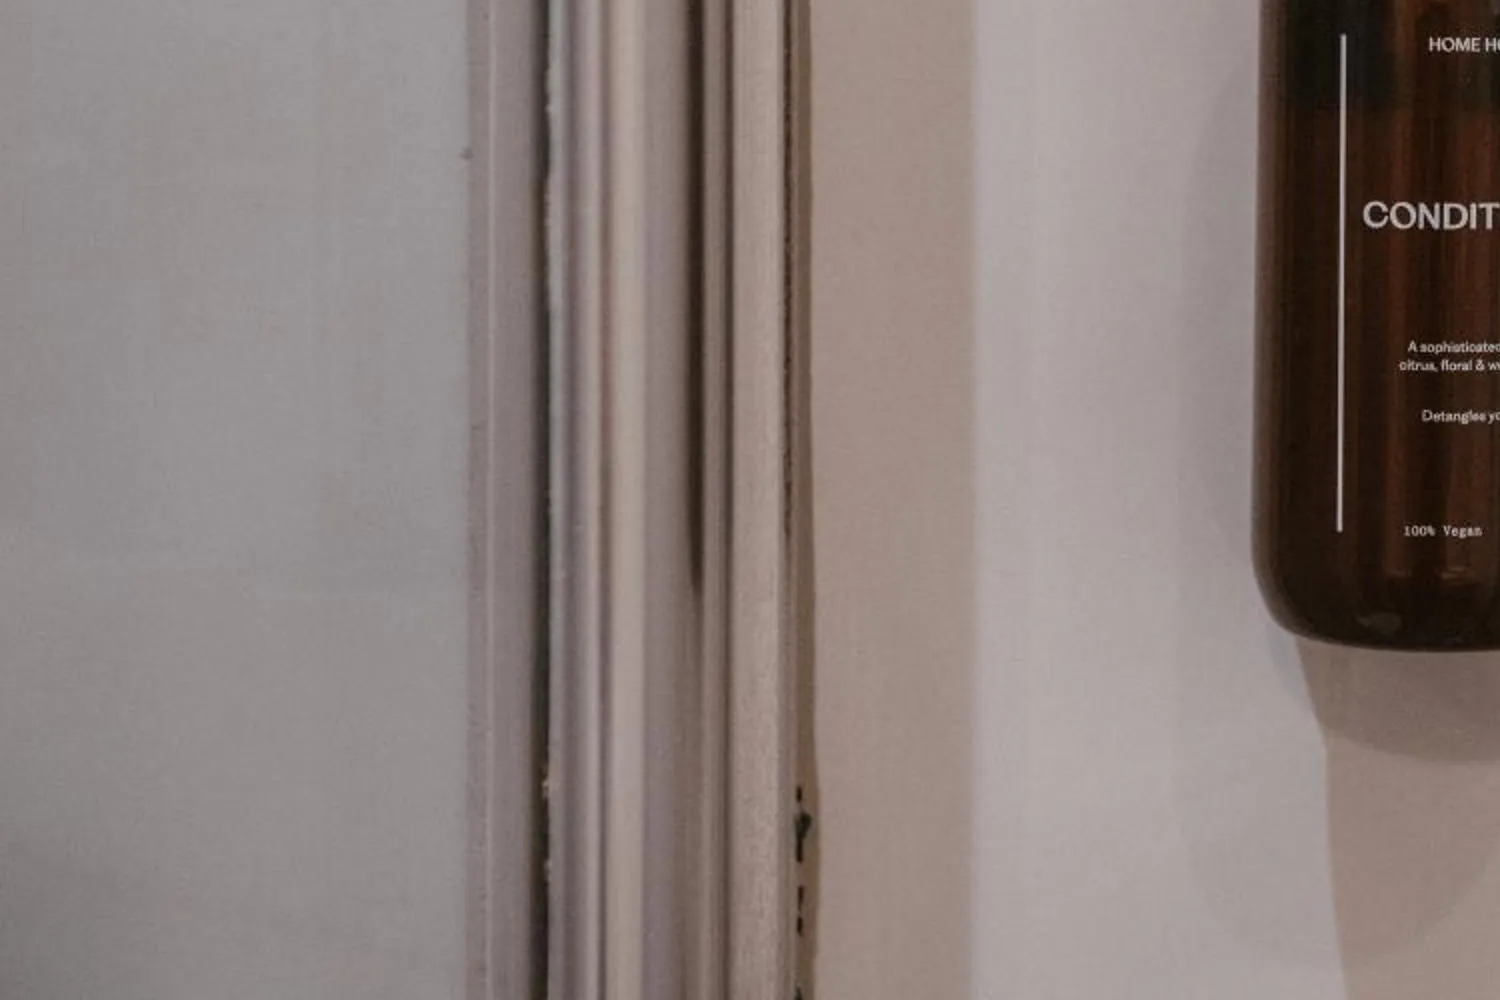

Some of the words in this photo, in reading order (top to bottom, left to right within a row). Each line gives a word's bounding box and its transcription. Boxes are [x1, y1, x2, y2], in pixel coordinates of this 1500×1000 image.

[1429, 37, 1480, 52] HOME
[1408, 341, 1418, 352] A
[1399, 361, 1438, 372] citrus,
[1441, 359, 1472, 371] floral
[1475, 359, 1485, 371] &
[1422, 410, 1486, 425] Detangles
[1404, 525, 1436, 537] 100%
[1443, 525, 1483, 539] Vegan
